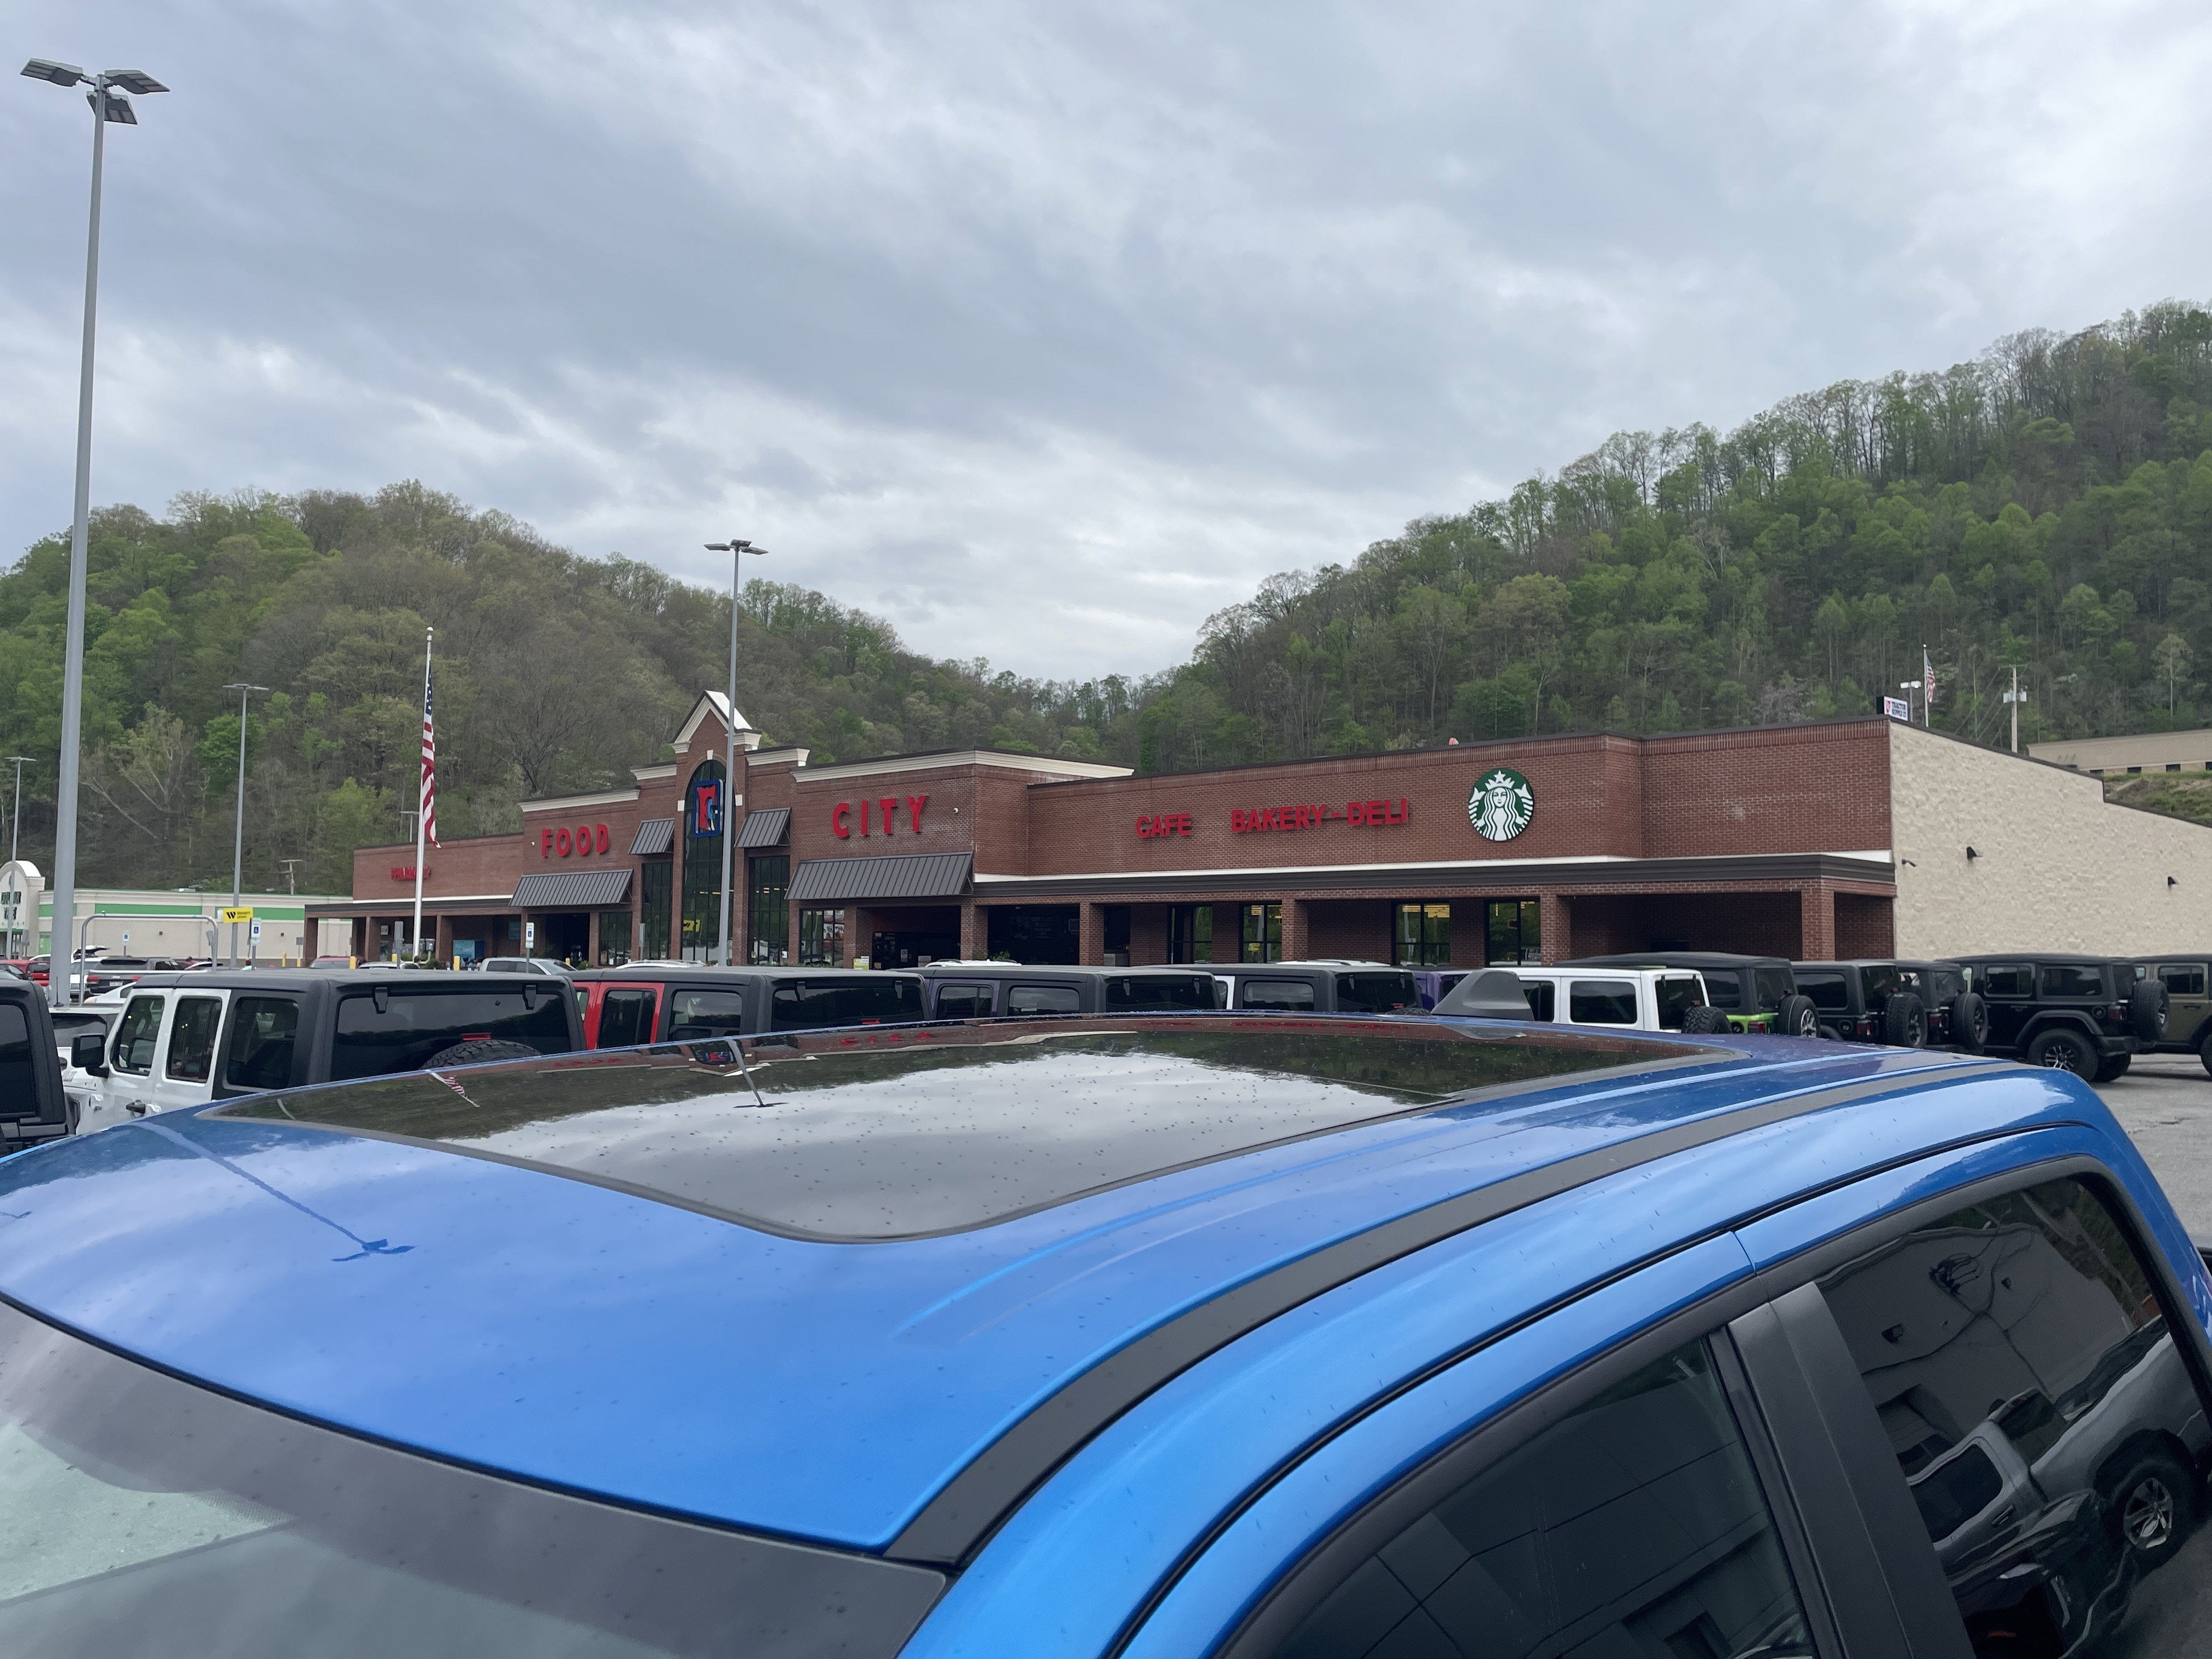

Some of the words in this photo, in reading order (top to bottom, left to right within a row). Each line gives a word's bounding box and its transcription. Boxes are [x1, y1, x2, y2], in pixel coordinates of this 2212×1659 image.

[833, 795, 927, 839] CITY
[1136, 813, 1191, 838] CAFE
[1231, 803, 1327, 832] BAKERY
[1347, 798, 1408, 826] DELI
[541, 823, 609, 857] FOOD
